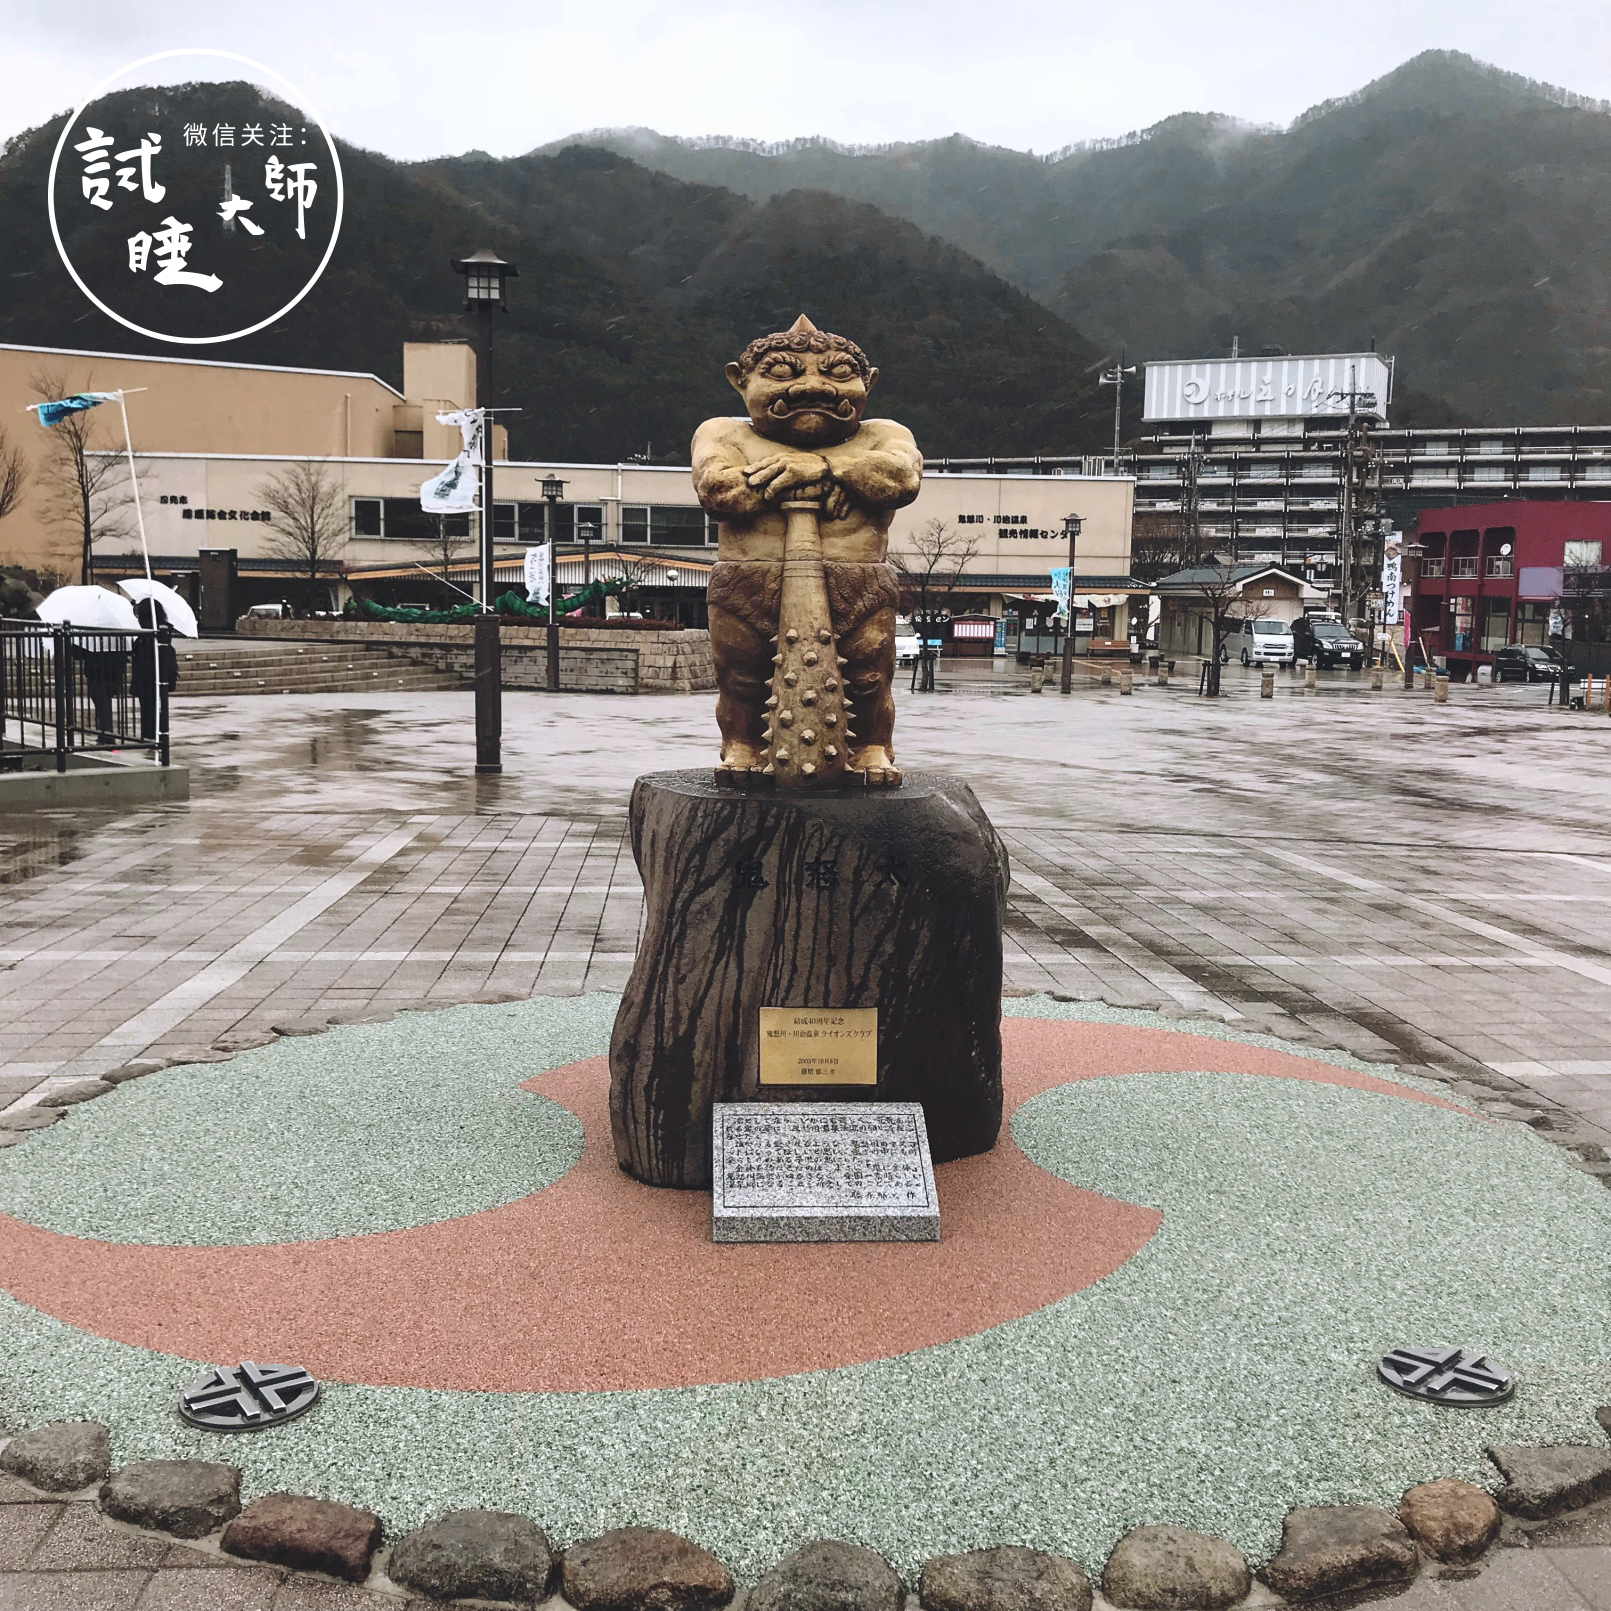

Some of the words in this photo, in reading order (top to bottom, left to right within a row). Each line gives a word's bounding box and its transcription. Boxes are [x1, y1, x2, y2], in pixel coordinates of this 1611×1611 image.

[998, 528, 1069, 540] 観光情報センタ
[793, 1017, 845, 1026] 結成40周年記念
[821, 1030, 872, 1038] ライオンズクラブ
